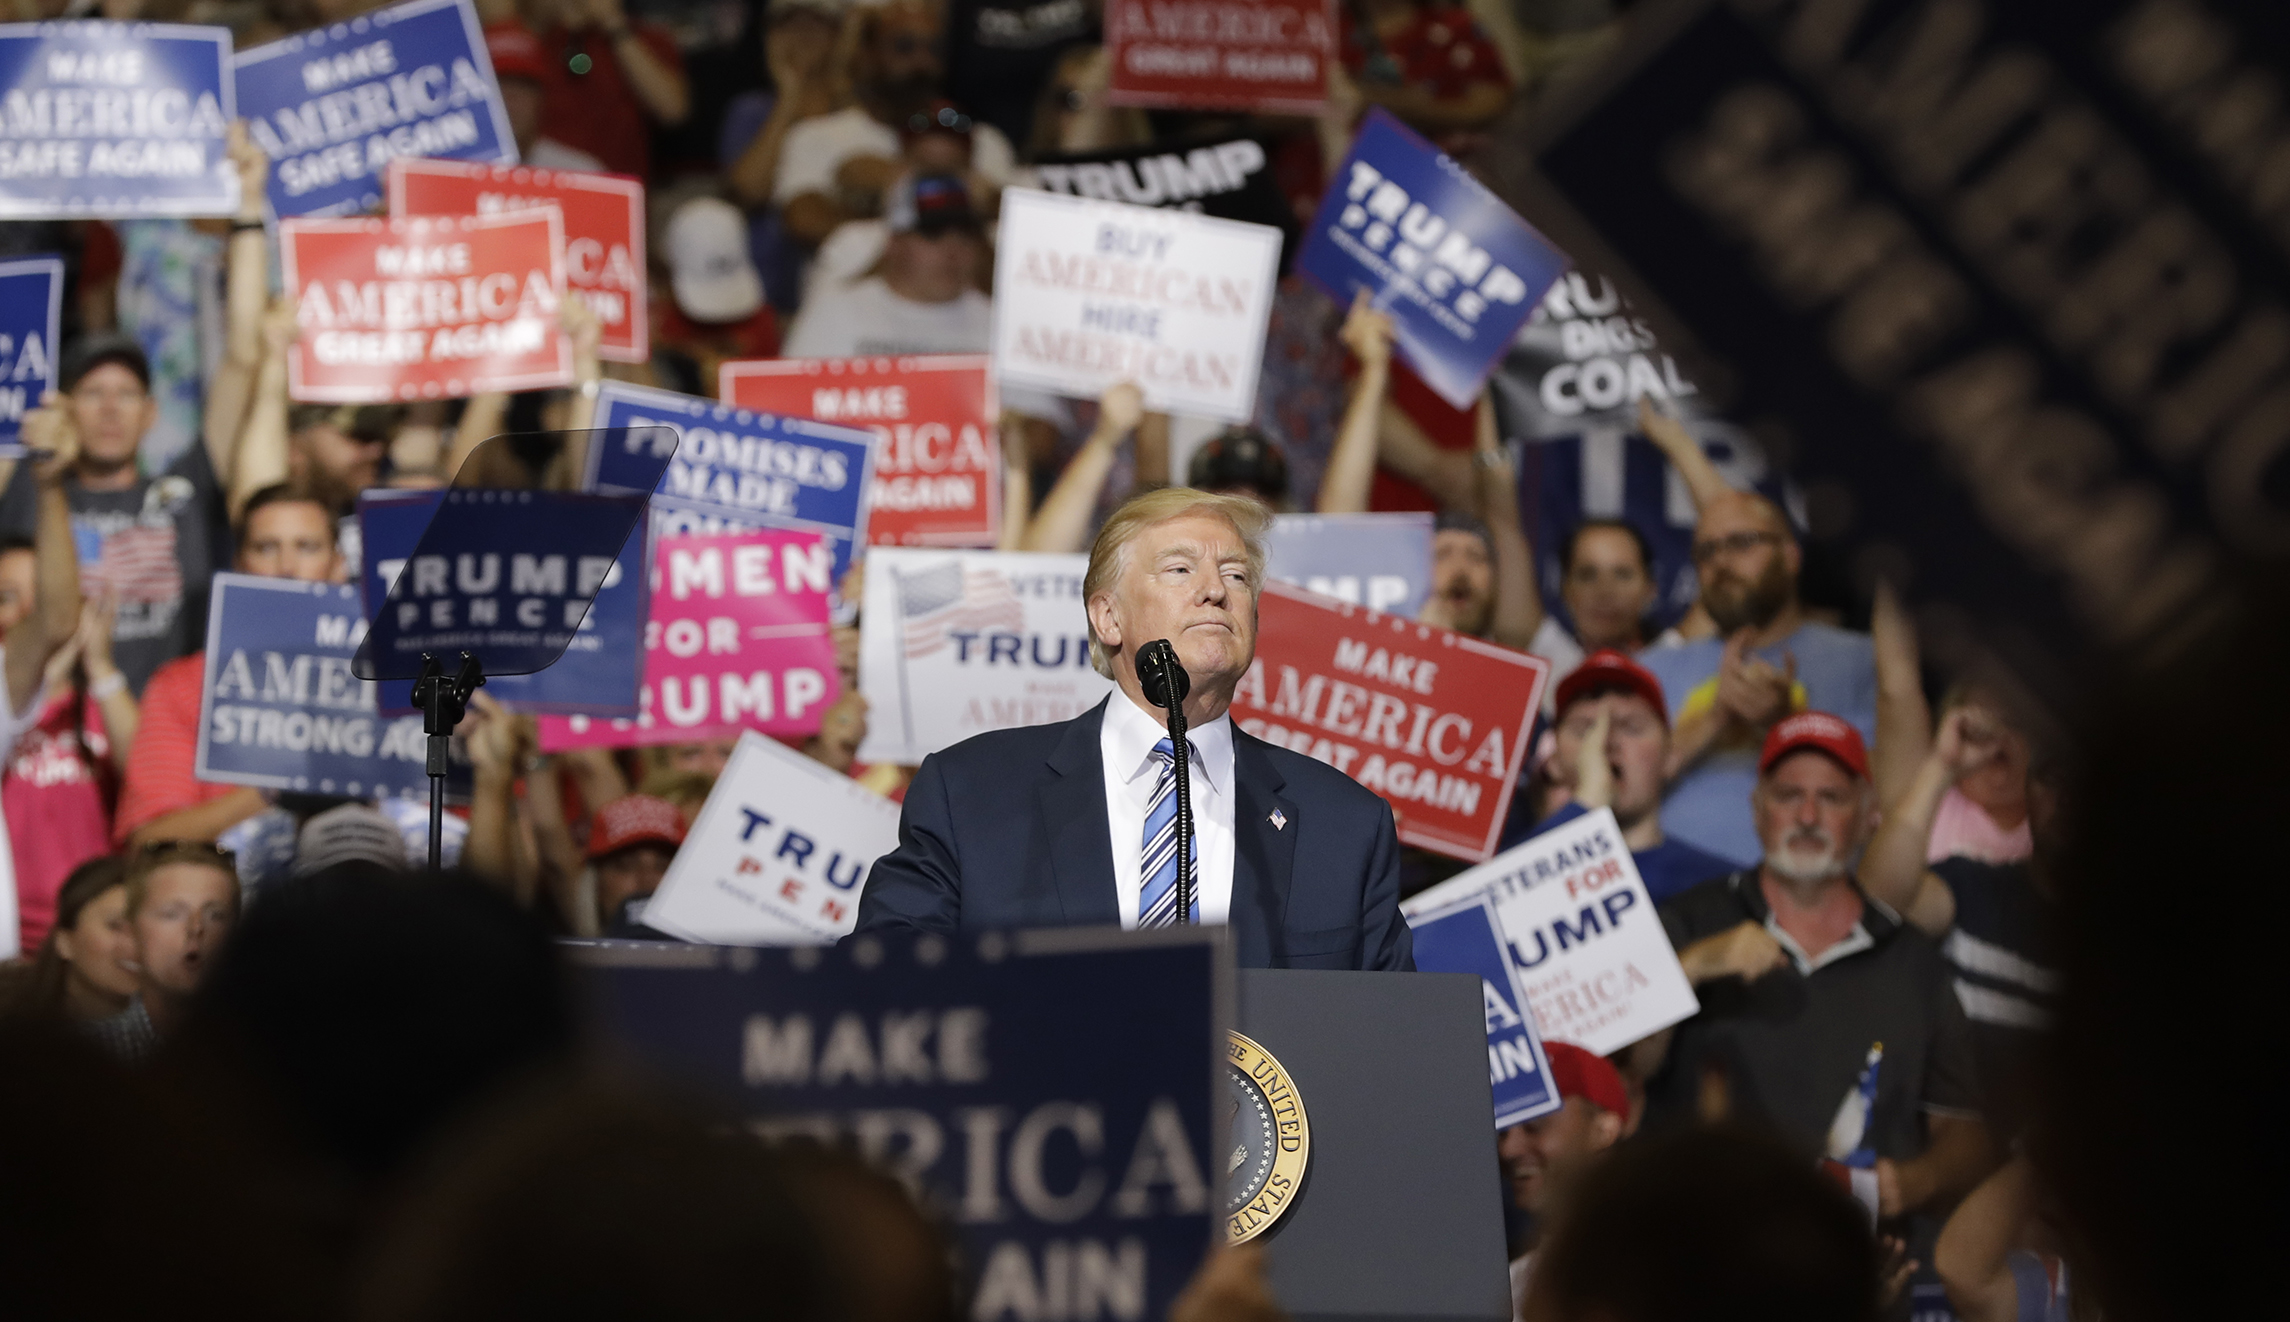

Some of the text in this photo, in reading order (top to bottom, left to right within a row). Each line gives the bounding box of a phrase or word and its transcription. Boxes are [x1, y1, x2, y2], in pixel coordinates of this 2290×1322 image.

[47, 50, 143, 84] MAKE
[302, 38, 398, 94] MAKE
[0, 86, 227, 139] MERICA
[250, 56, 491, 163] AMERICA
[88, 140, 204, 178] AGAIN
[278, 107, 479, 197] SAFE AGAIN
[1038, 138, 1266, 206] TRUMP
[374, 242, 472, 276] MAKE
[1096, 222, 1172, 262] BUY
[1346, 158, 1528, 306] TRUMP
[1012, 250, 1252, 318] AMERICAN
[1339, 200, 1489, 335] PENCE
[296, 268, 562, 330] AMERICA
[1081, 302, 1164, 346] HIRE
[313, 318, 548, 367] GREAT AGAIN
[1008, 326, 1240, 390] AMERICAN
[1560, 316, 1658, 361] DIGS
[811, 385, 910, 420] MAKE
[1538, 353, 1699, 417] COAL
[623, 414, 850, 492] PROMISES
[664, 460, 800, 519] MADE
[376, 551, 624, 600] TRUMP
[650, 543, 832, 602] MEN
[396, 599, 597, 635] PENCE
[1333, 636, 1438, 695] MAKE
[211, 702, 375, 759] STRONG
[1230, 655, 1508, 780] AMERICA
[1355, 752, 1483, 818] AGAIN
[1564, 858, 1626, 899] FOR
[740, 1004, 990, 1088] MAKE
[1252, 1058, 1303, 1154] UNITED
